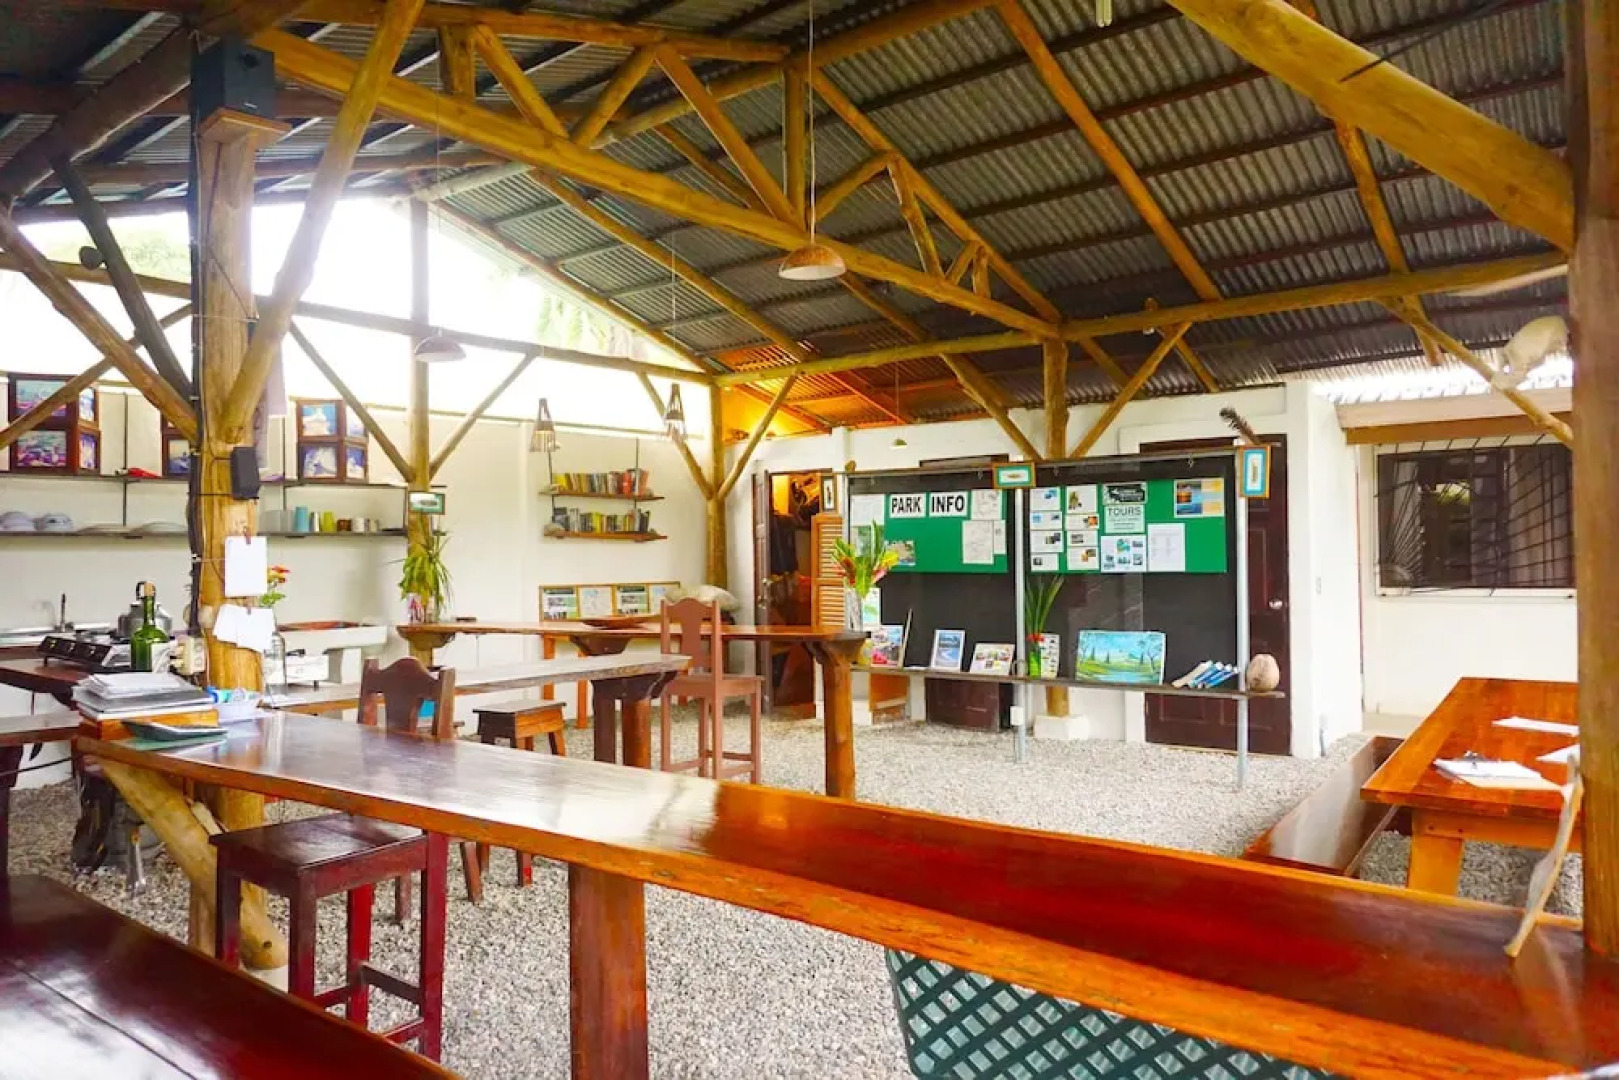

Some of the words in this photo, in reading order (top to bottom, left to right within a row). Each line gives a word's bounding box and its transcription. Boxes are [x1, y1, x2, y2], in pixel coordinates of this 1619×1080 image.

[892, 497, 921, 513] PARK
[931, 495, 965, 512] INFO
[1107, 506, 1141, 516] TOURS
